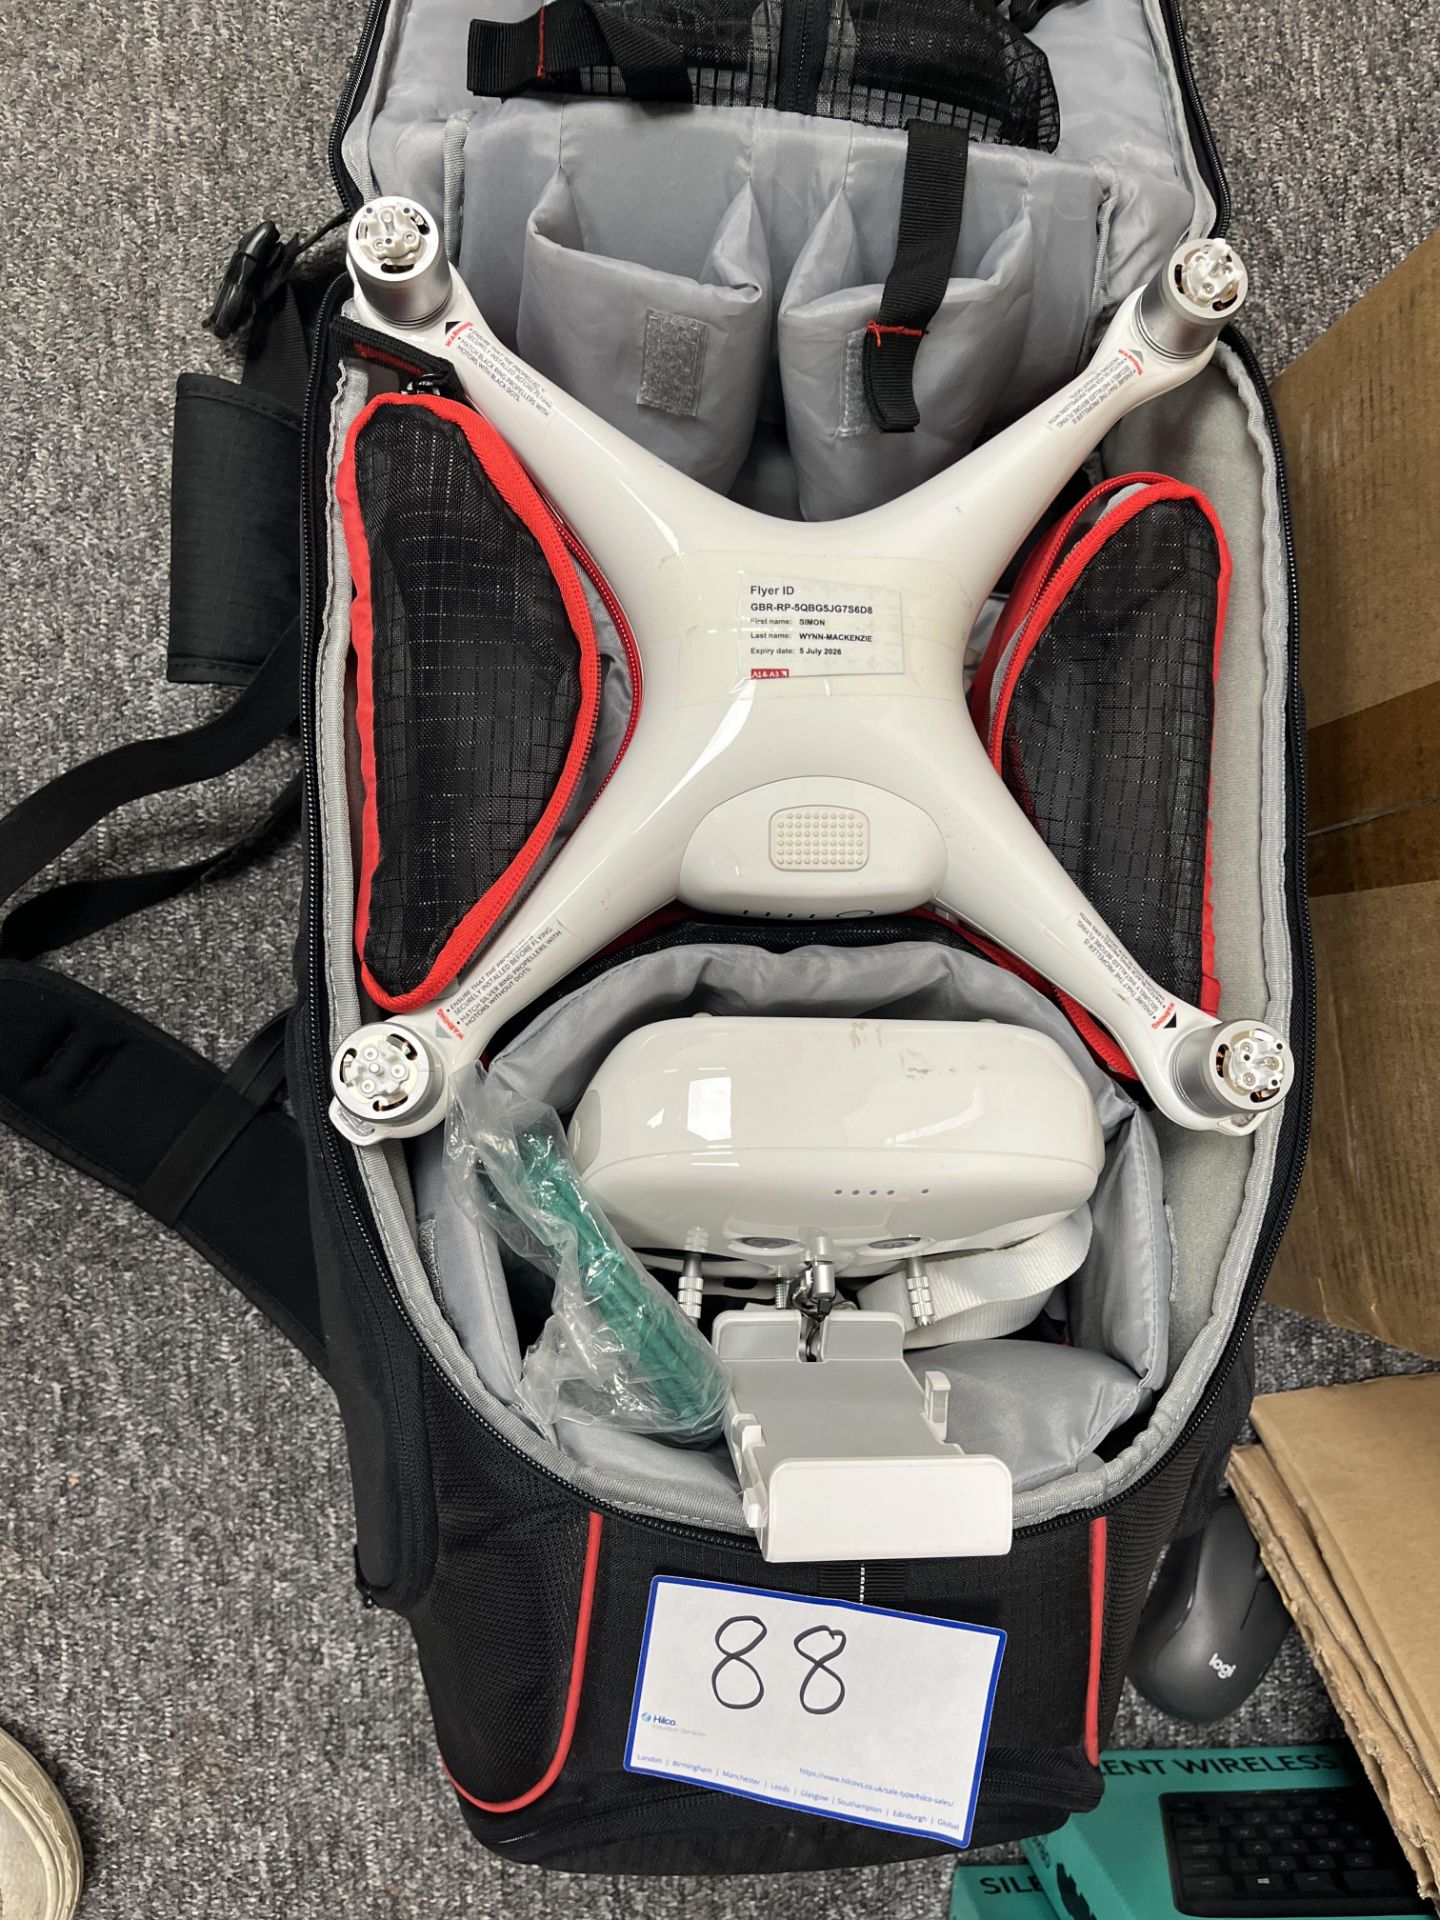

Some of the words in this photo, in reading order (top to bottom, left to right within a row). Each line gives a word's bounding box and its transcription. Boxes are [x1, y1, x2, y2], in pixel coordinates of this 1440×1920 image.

[750, 586, 779, 597] Flyer
[783, 586, 794, 595] ID
[799, 633, 872, 642] WYNN-MACKENZIE
[450, 990, 470, 1009] ENSURE
[471, 976, 485, 989] THAT
[485, 967, 496, 977] THE
[454, 989, 481, 1014] SECURELY
[481, 963, 510, 990] INSTALLED
[509, 944, 532, 965] BEFORE
[460, 1002, 480, 1021] MATCH
[480, 985, 499, 1003] SILVER
[498, 973, 513, 987] RING
[512, 943, 546, 974] PROPELLERS
[545, 930, 561, 944] WITH
[464, 1003, 489, 1026] MOTORS
[488, 981, 514, 1005] WITHOUT
[1209, 1652, 1236, 1679] logi
[653, 1715, 676, 1726] Hilco
[1101, 1758, 1167, 1776] ENT
[1172, 1754, 1337, 1775] WIRELESS
[637, 1754, 662, 1764] London
[672, 1760, 712, 1773] Birmingham
[722, 1770, 760, 1785] Manchester
[771, 1783, 790, 1793] Leeds
[800, 1789, 829, 1802] Glasgow
[837, 1798, 882, 1814] Southampton
[893, 1810, 927, 1823] Edinburgh
[937, 1818, 959, 1830] Global
